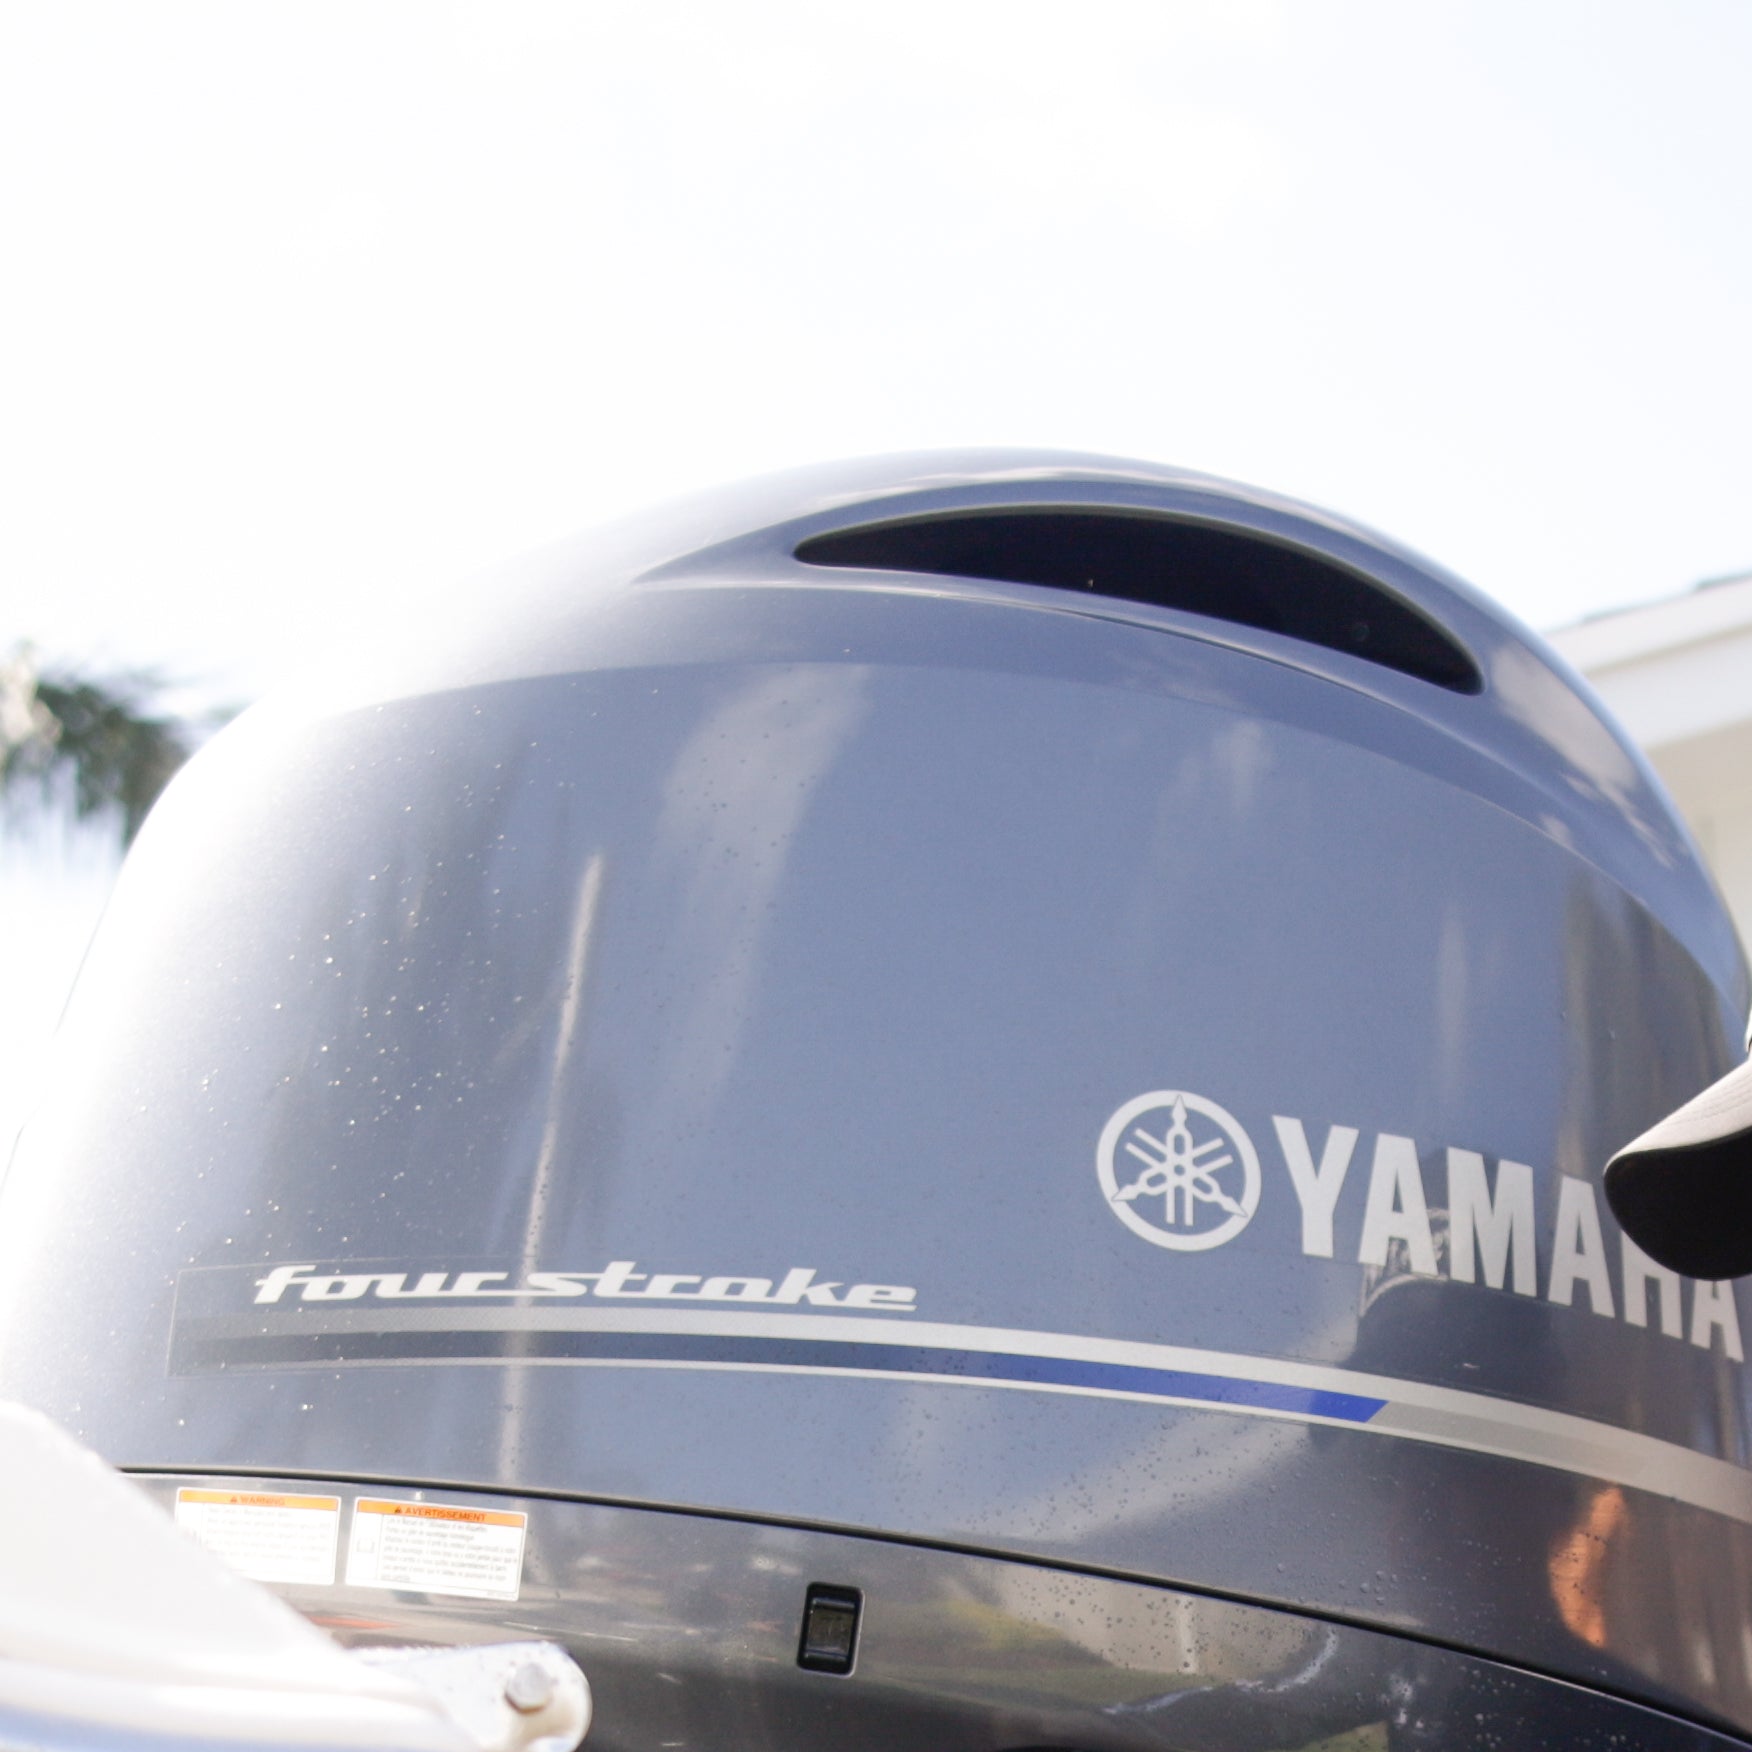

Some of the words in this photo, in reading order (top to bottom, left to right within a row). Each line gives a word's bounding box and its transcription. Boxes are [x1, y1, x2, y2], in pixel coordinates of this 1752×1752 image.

[1272, 1115, 1744, 1362] YAMAHA
[240, 1496, 286, 1507] WARNING
[404, 1507, 487, 1523] AVERTISSEMENT
